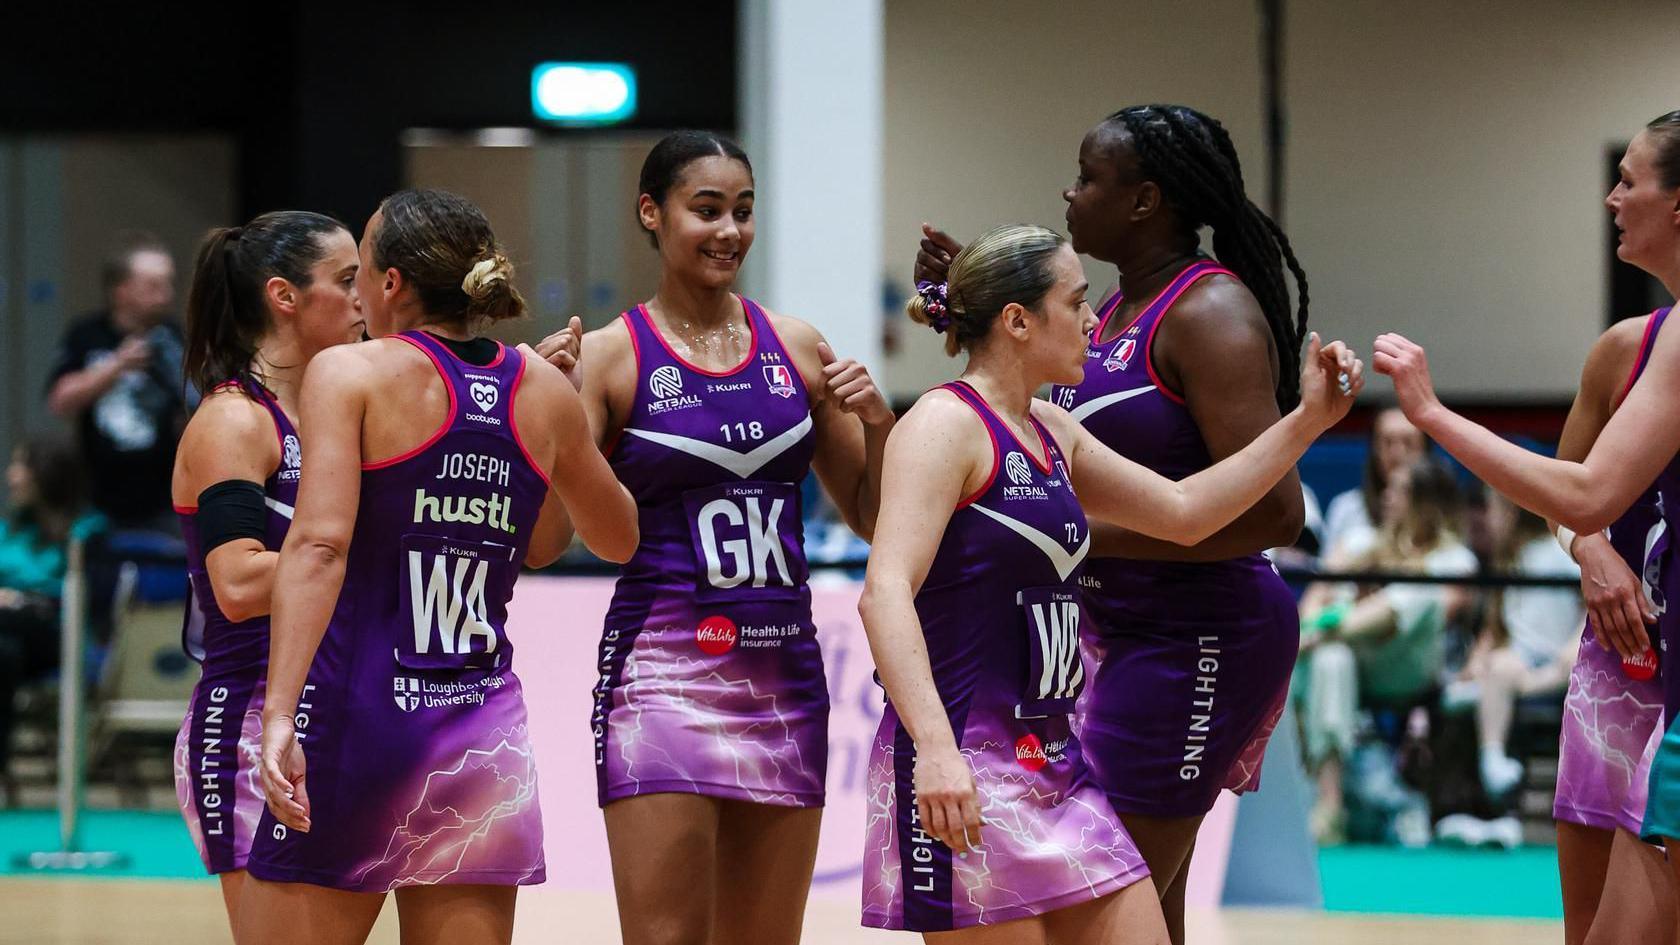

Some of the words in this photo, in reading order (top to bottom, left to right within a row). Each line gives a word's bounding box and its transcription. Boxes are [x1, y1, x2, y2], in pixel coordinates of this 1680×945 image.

[715, 383, 752, 392] KUKRI
[1056, 387, 1076, 408] 115
[647, 395, 702, 412] NETBALL
[466, 413, 501, 426] boobydoo
[720, 421, 764, 442] 118
[436, 453, 510, 487] JOSEPH
[413, 488, 516, 534] hustl.
[1064, 522, 1079, 543] 72
[449, 547, 478, 558] KUKRI
[697, 497, 794, 589] GK
[1083, 575, 1101, 588] Life
[408, 550, 497, 654] WA
[697, 625, 736, 645] Vitality
[741, 625, 779, 638] Health
[781, 629, 786, 637] &
[787, 623, 800, 636] Life
[740, 639, 782, 648] insurance
[423, 691, 485, 708] University
[1180, 636, 1221, 781] LIGHTNING
[201, 686, 229, 835] LIGHTNING
